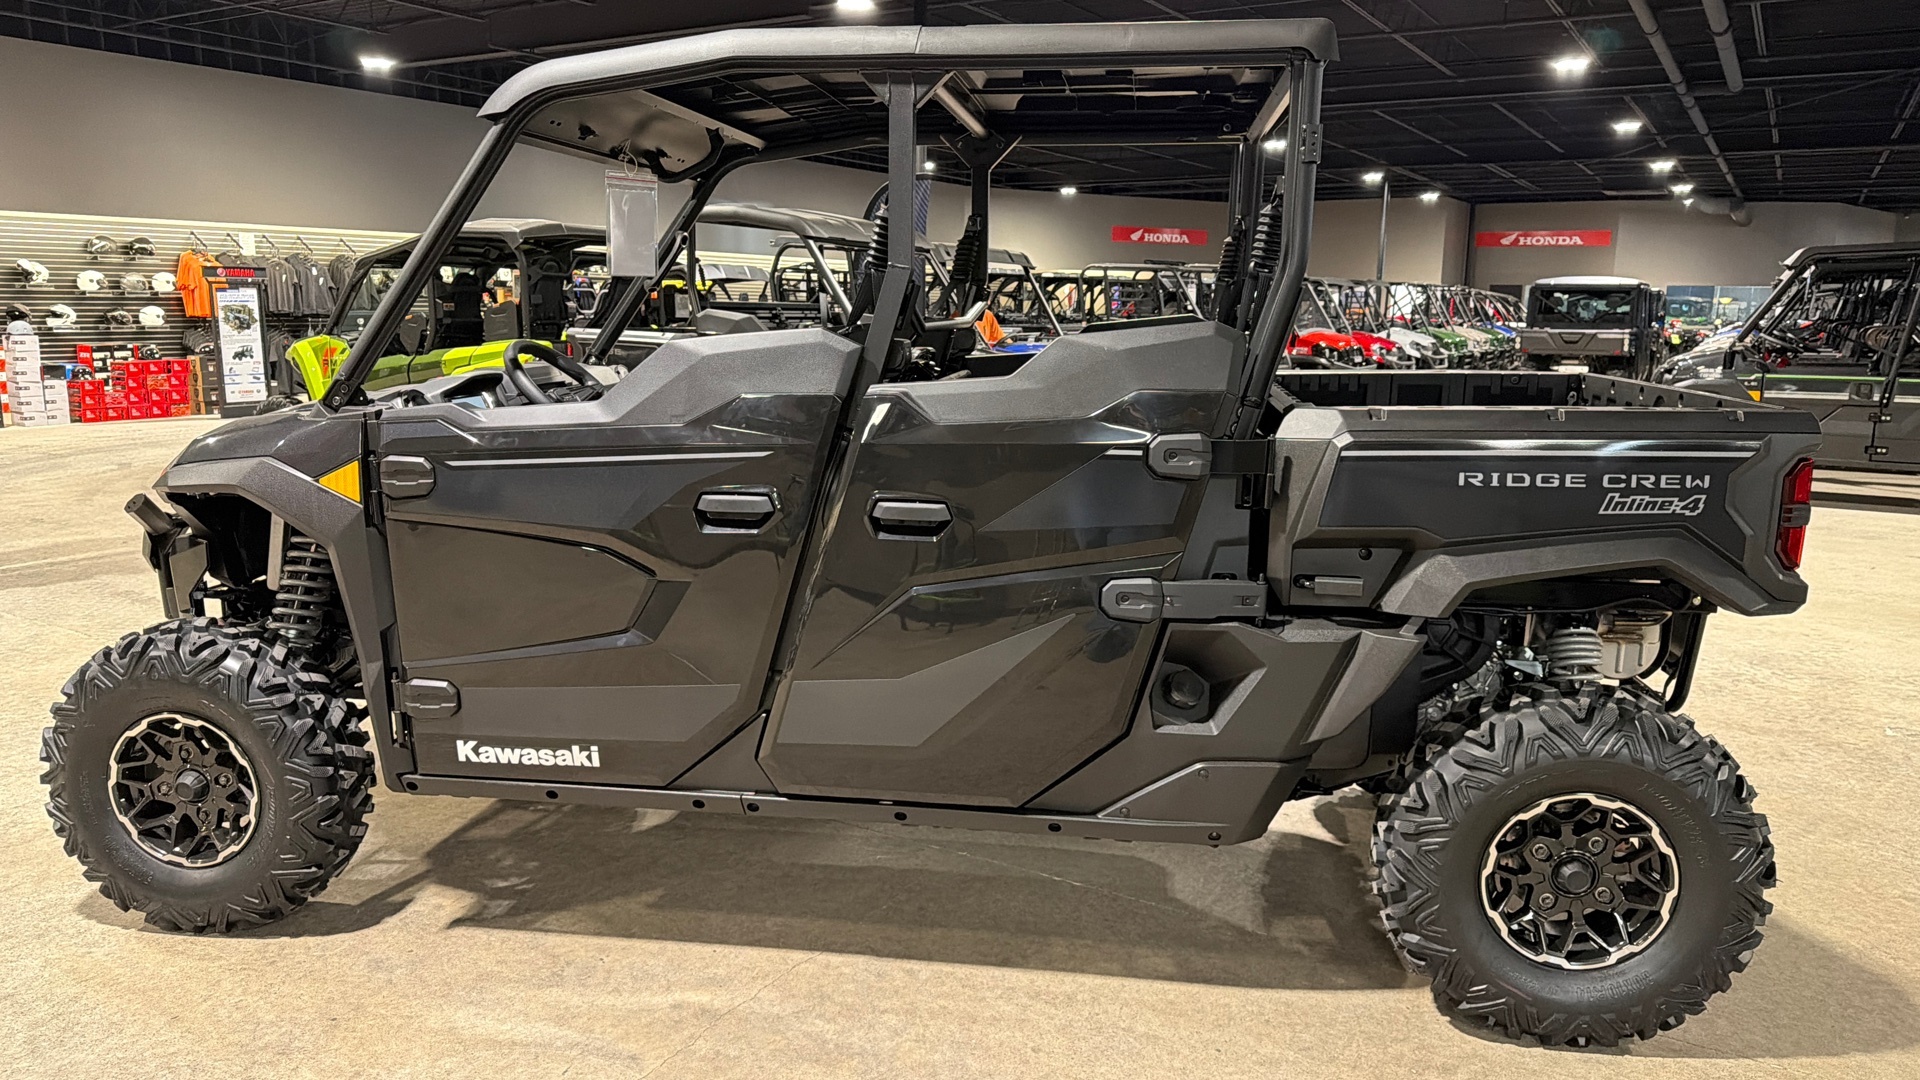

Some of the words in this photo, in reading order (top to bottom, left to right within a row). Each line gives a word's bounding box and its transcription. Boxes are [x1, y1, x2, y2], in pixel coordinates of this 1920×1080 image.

[1143, 233, 1190, 244] HONDA
[1518, 236, 1584, 246] HONDA
[225, 268, 256, 277] YAMAHA
[1458, 472, 1588, 488] RIDGE
[1602, 474, 1711, 489] CREW
[1598, 492, 1707, 517] Inline-4
[456, 739, 601, 768] Kawasaki
